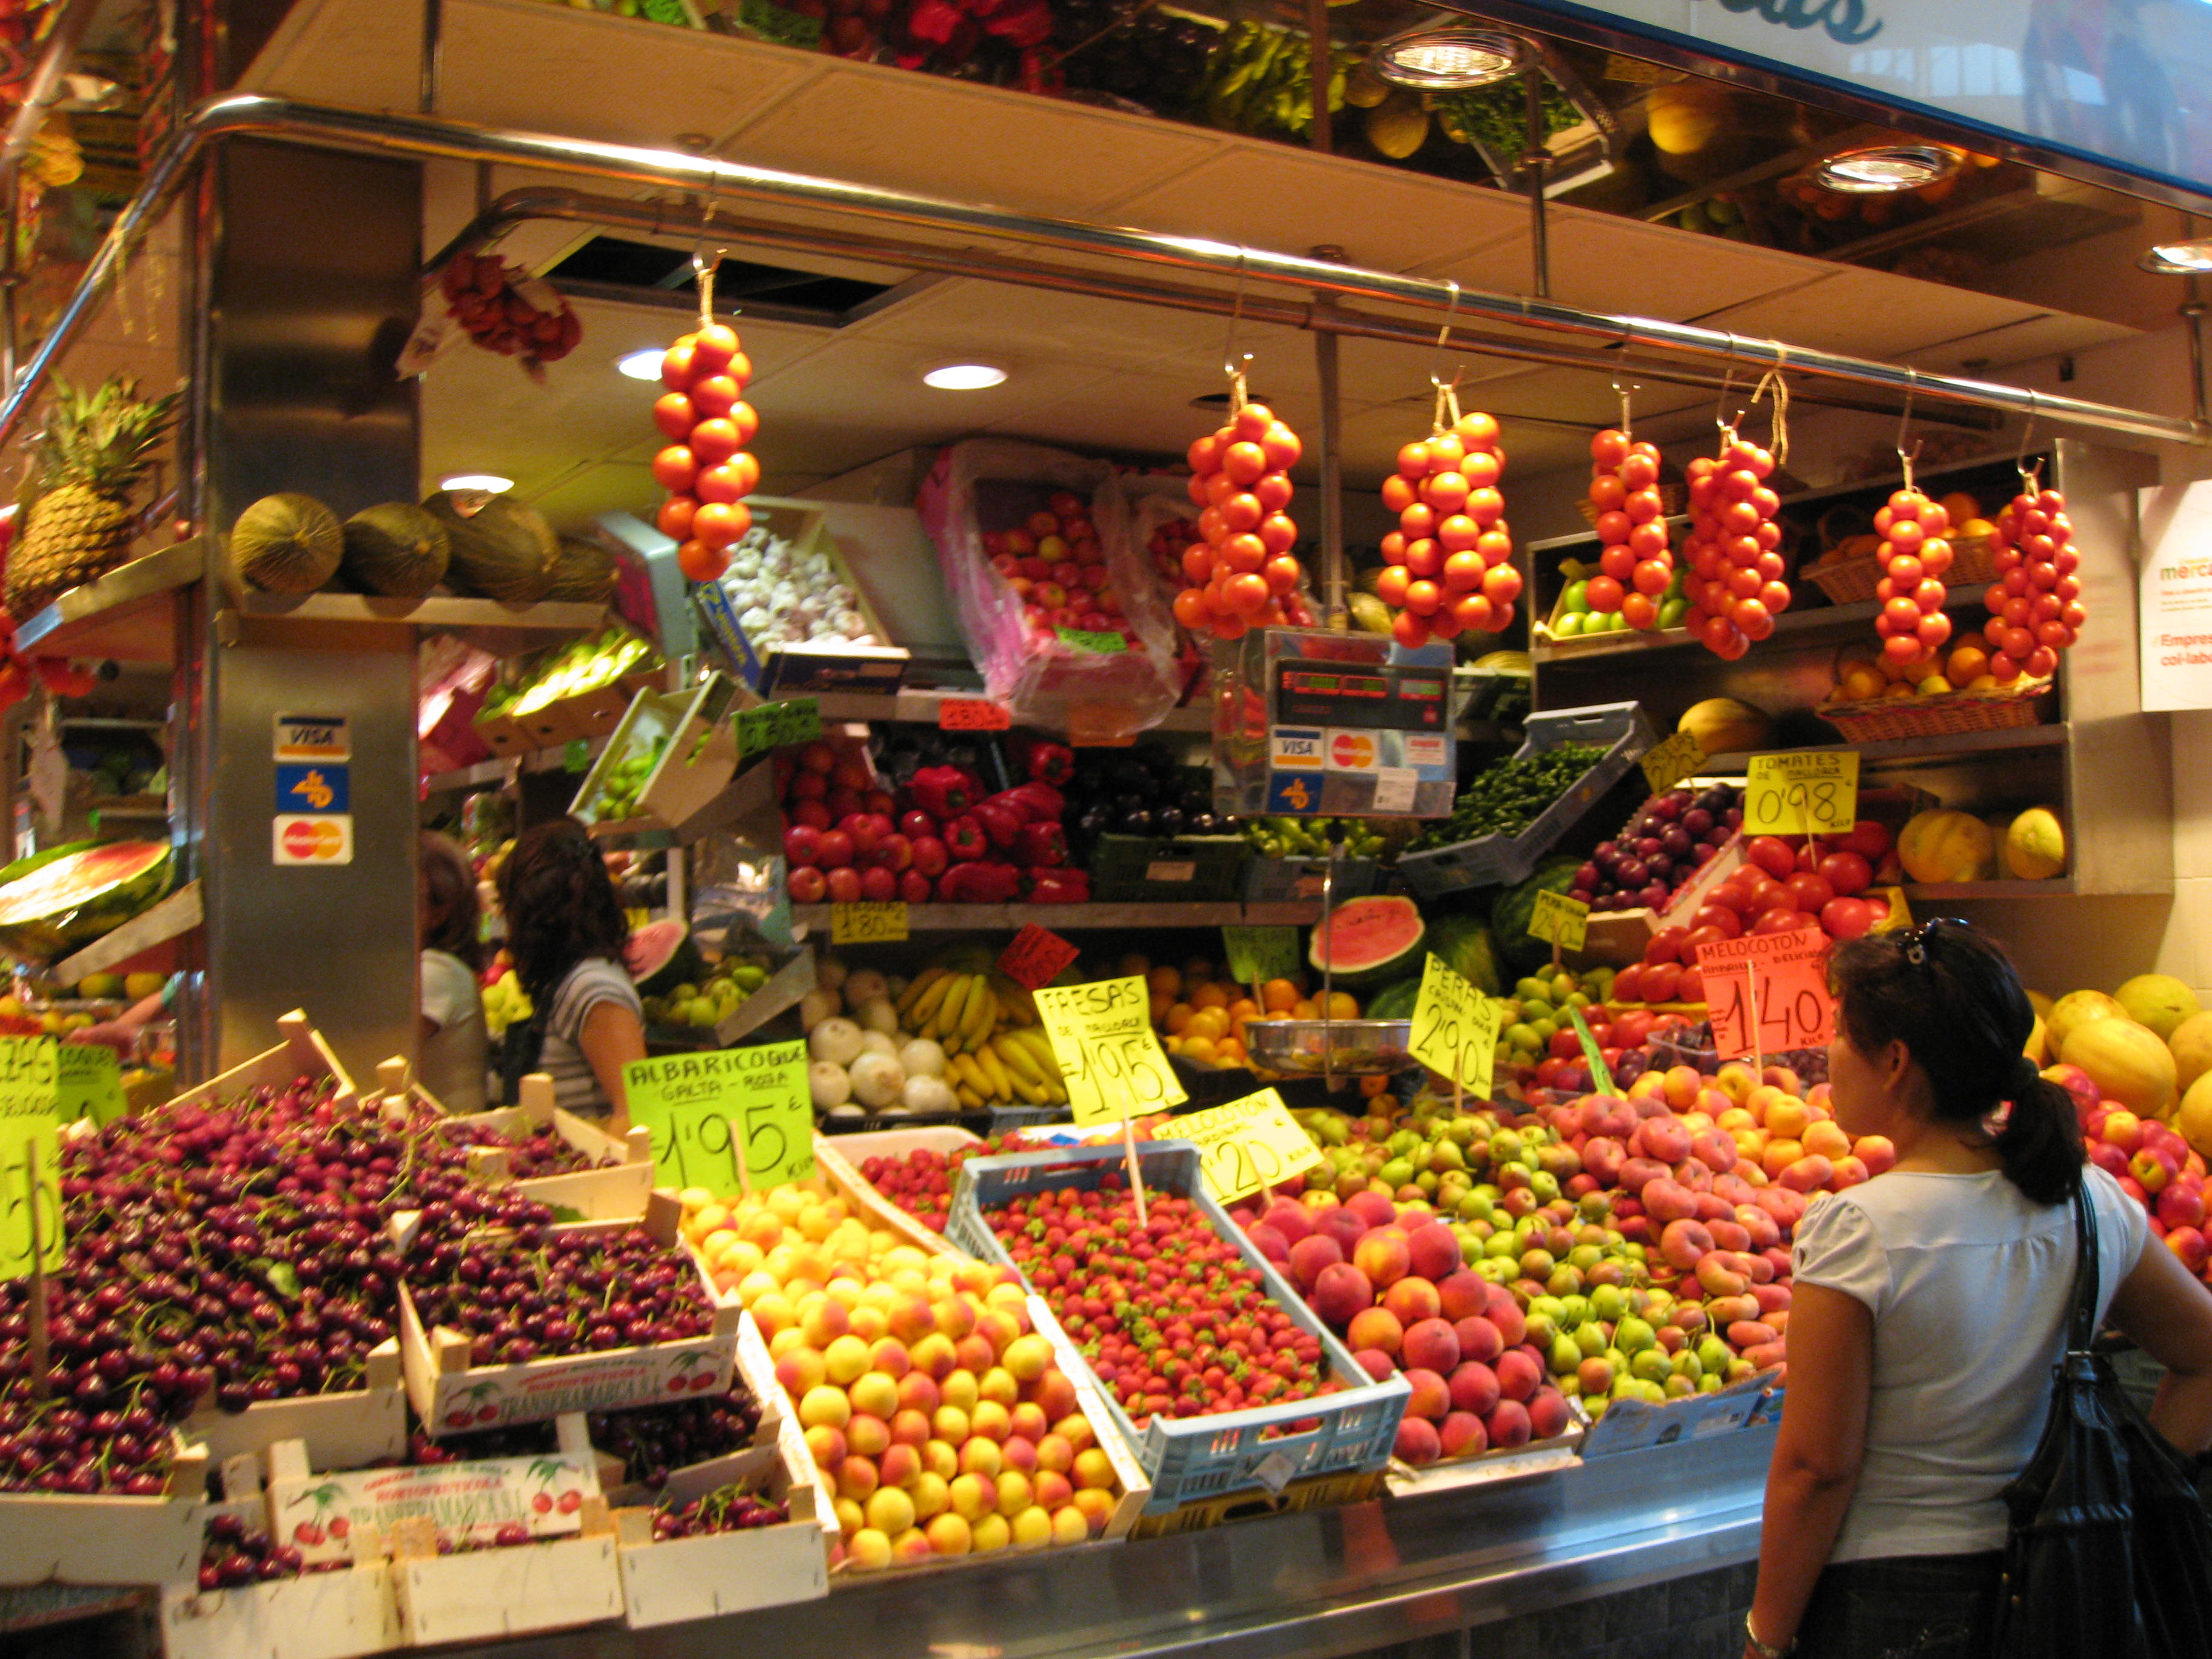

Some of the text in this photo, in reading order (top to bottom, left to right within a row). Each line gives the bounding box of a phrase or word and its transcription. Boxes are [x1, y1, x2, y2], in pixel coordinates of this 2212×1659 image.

[292, 729, 333, 745] VISA
[1282, 741, 1313, 755] VISA
[1757, 754, 1840, 769] TOMATES
[1757, 782, 1837, 824] 0'98
[1043, 982, 1141, 1016] FRESAS
[1430, 957, 1492, 1021] PERAS
